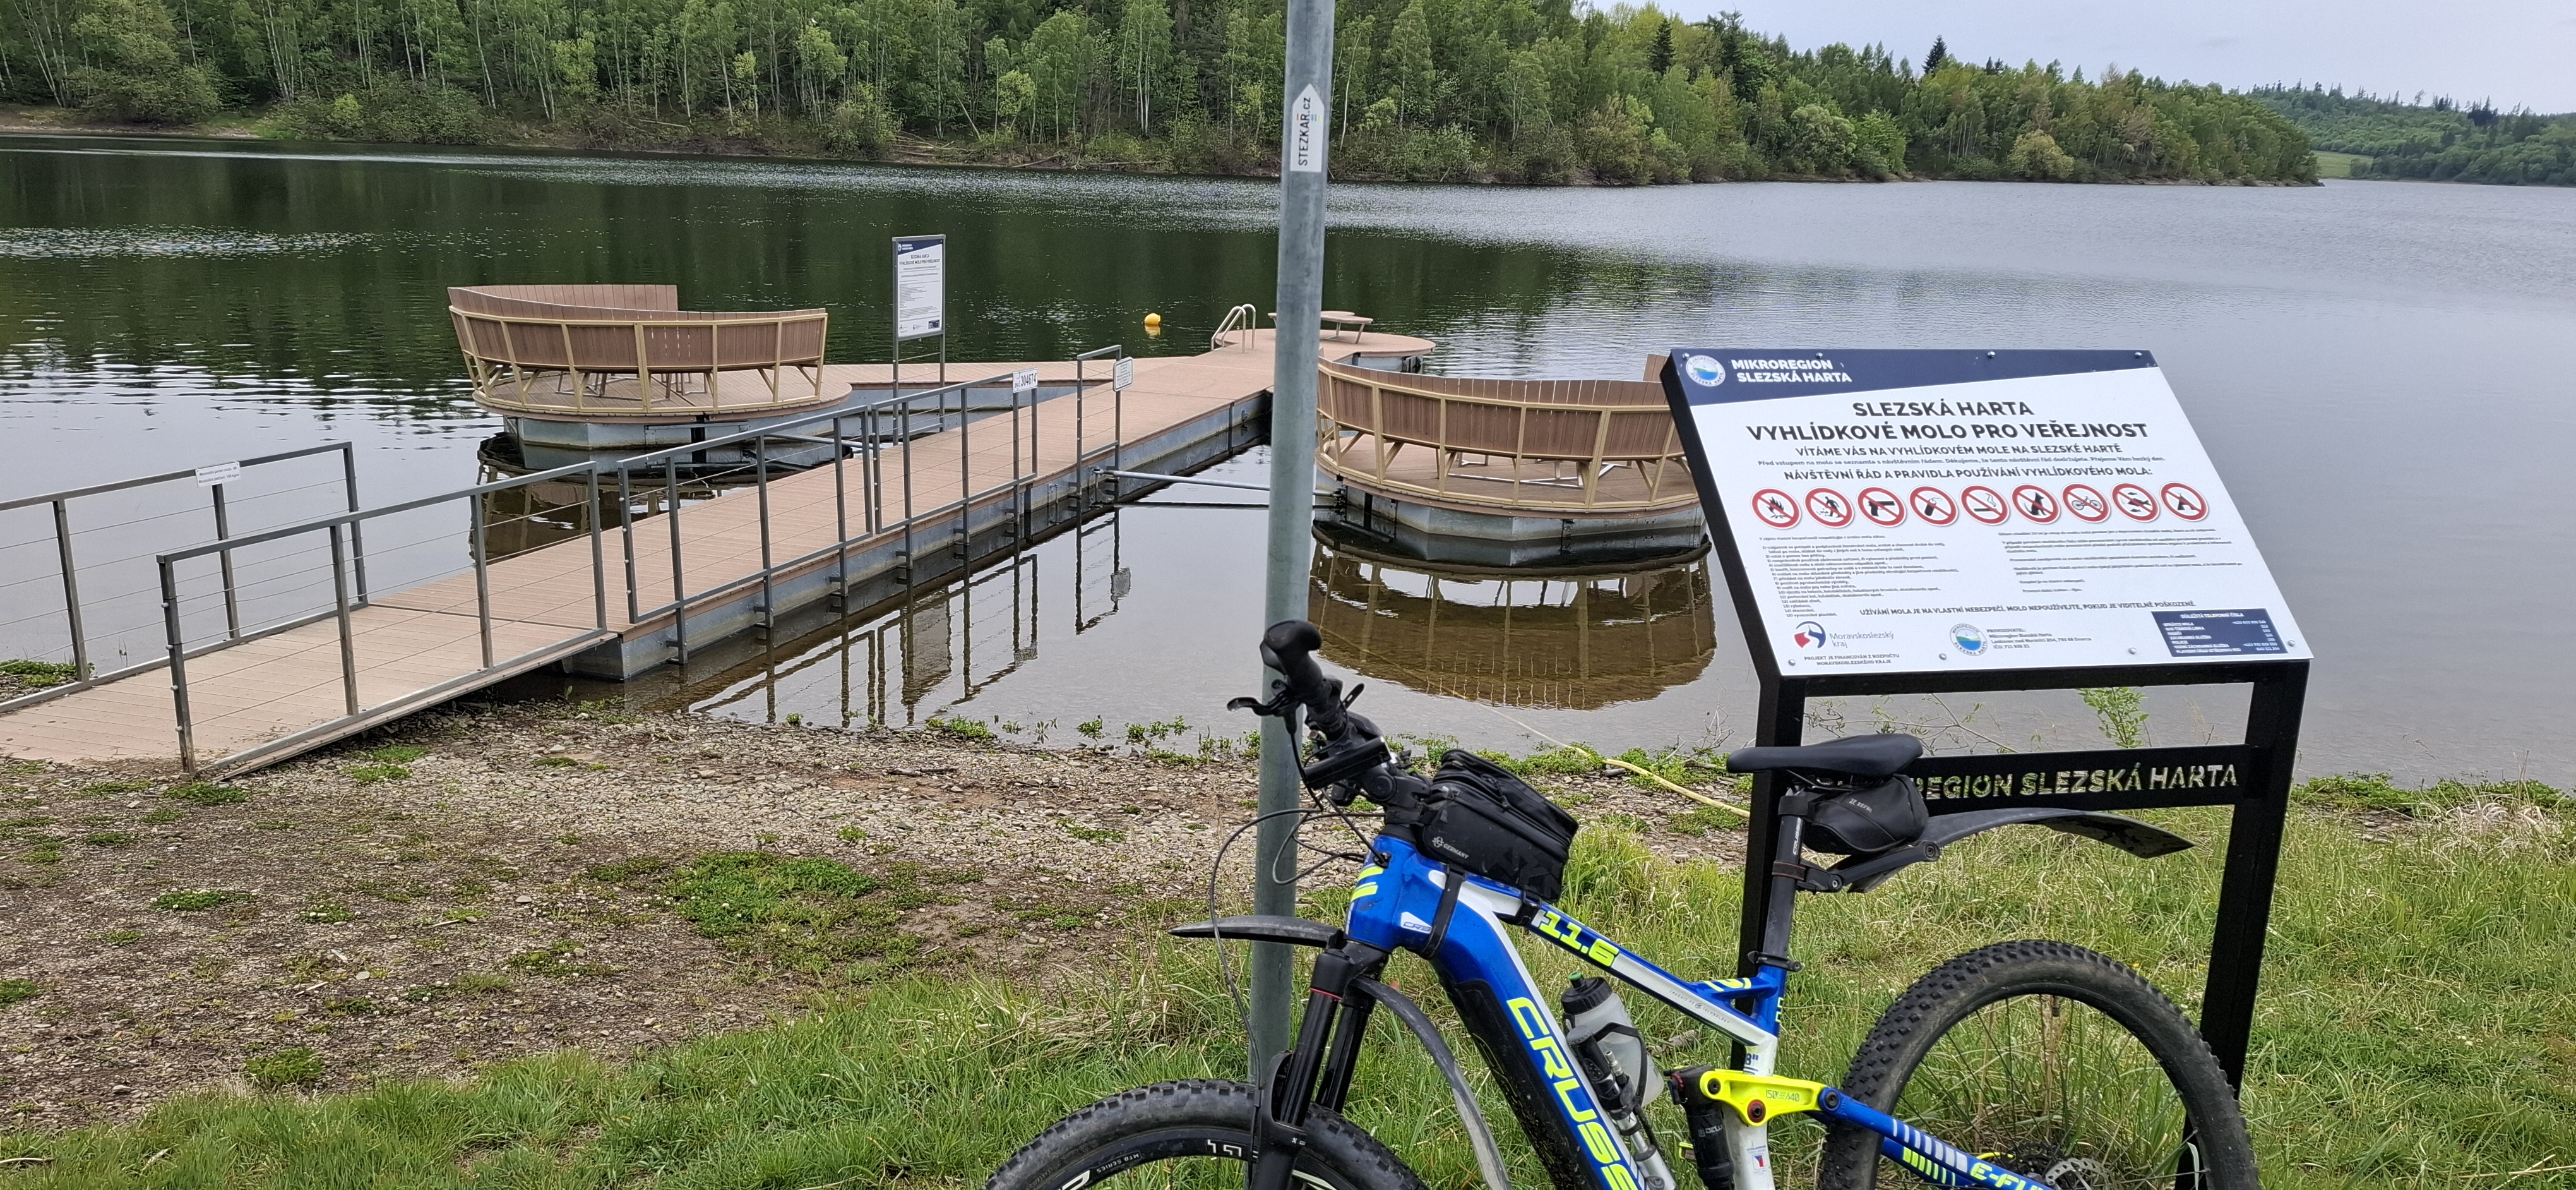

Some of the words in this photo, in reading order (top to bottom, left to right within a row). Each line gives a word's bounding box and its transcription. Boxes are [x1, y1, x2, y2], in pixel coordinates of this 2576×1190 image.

[1297, 97, 1312, 167] STEZKAR.cz
[1731, 360, 1833, 369] MIKROREGION
[1737, 370, 1801, 382] SLEZSKÁ
[1803, 373, 1852, 382] HARTA
[1853, 399, 1955, 416] SLEZSKÁ
[1957, 402, 2034, 416] HARTA
[1746, 421, 1897, 440] VYHLÍDKOVÉ
[1901, 425, 1967, 439] MOLO
[1973, 424, 2022, 438] PRO
[2022, 420, 2147, 437] VEŘEJNOST
[1796, 446, 1842, 455] VÍTÁME
[1842, 446, 1866, 455] VÁS
[1887, 445, 1974, 455] VYHLÍDKOVÉM
[2030, 443, 2082, 453] SLEZSKÉ
[2083, 443, 2122, 452] HARTĚ
[1784, 469, 1854, 479] NÁVŠTĚVNÍ
[1856, 469, 1881, 479] ŘÁD
[1894, 470, 1954, 478] PRAVIDLA
[1955, 467, 2020, 477] POUŽÍVÁNÍ
[2022, 466, 2113, 476] VYHLÍDKOVÉHO
[2020, 761, 2142, 795] SLEZSKÁ
[2148, 764, 2239, 790] HARTA
[1443, 843, 1469, 860] GERMANY
[1539, 911, 1619, 966] 11.6
